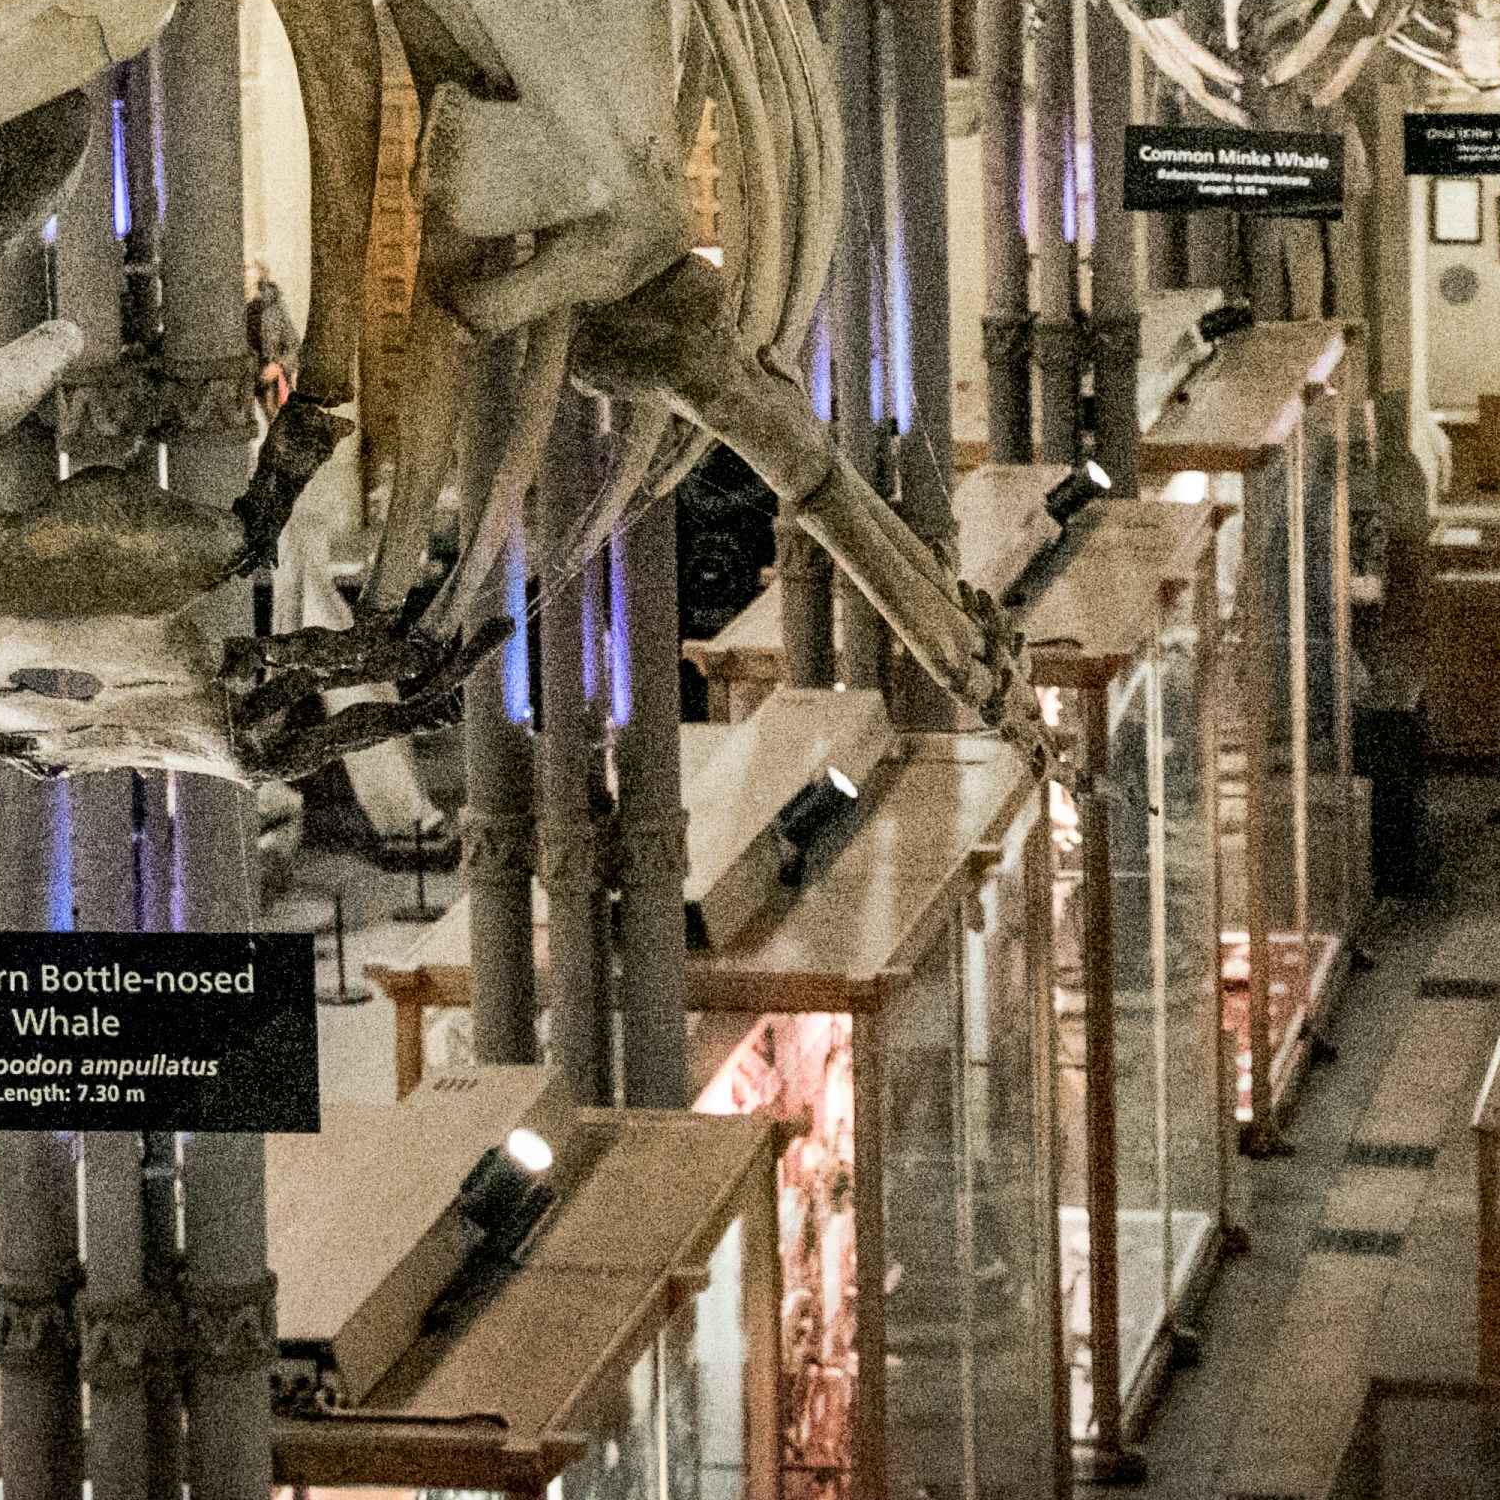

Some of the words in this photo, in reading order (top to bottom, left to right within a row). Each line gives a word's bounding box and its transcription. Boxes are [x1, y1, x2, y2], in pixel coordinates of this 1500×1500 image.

[1138, 144, 1214, 163] Common
[1218, 149, 1271, 167] Minke
[1275, 151, 1330, 169] Whale
[41, 962, 255, 994] Bottle-nosed
[11, 1006, 120, 1037] Whale
[80, 1053, 219, 1081] ampullatus
[77, 1084, 120, 1103] 7.30
[126, 1088, 145, 1102] m
